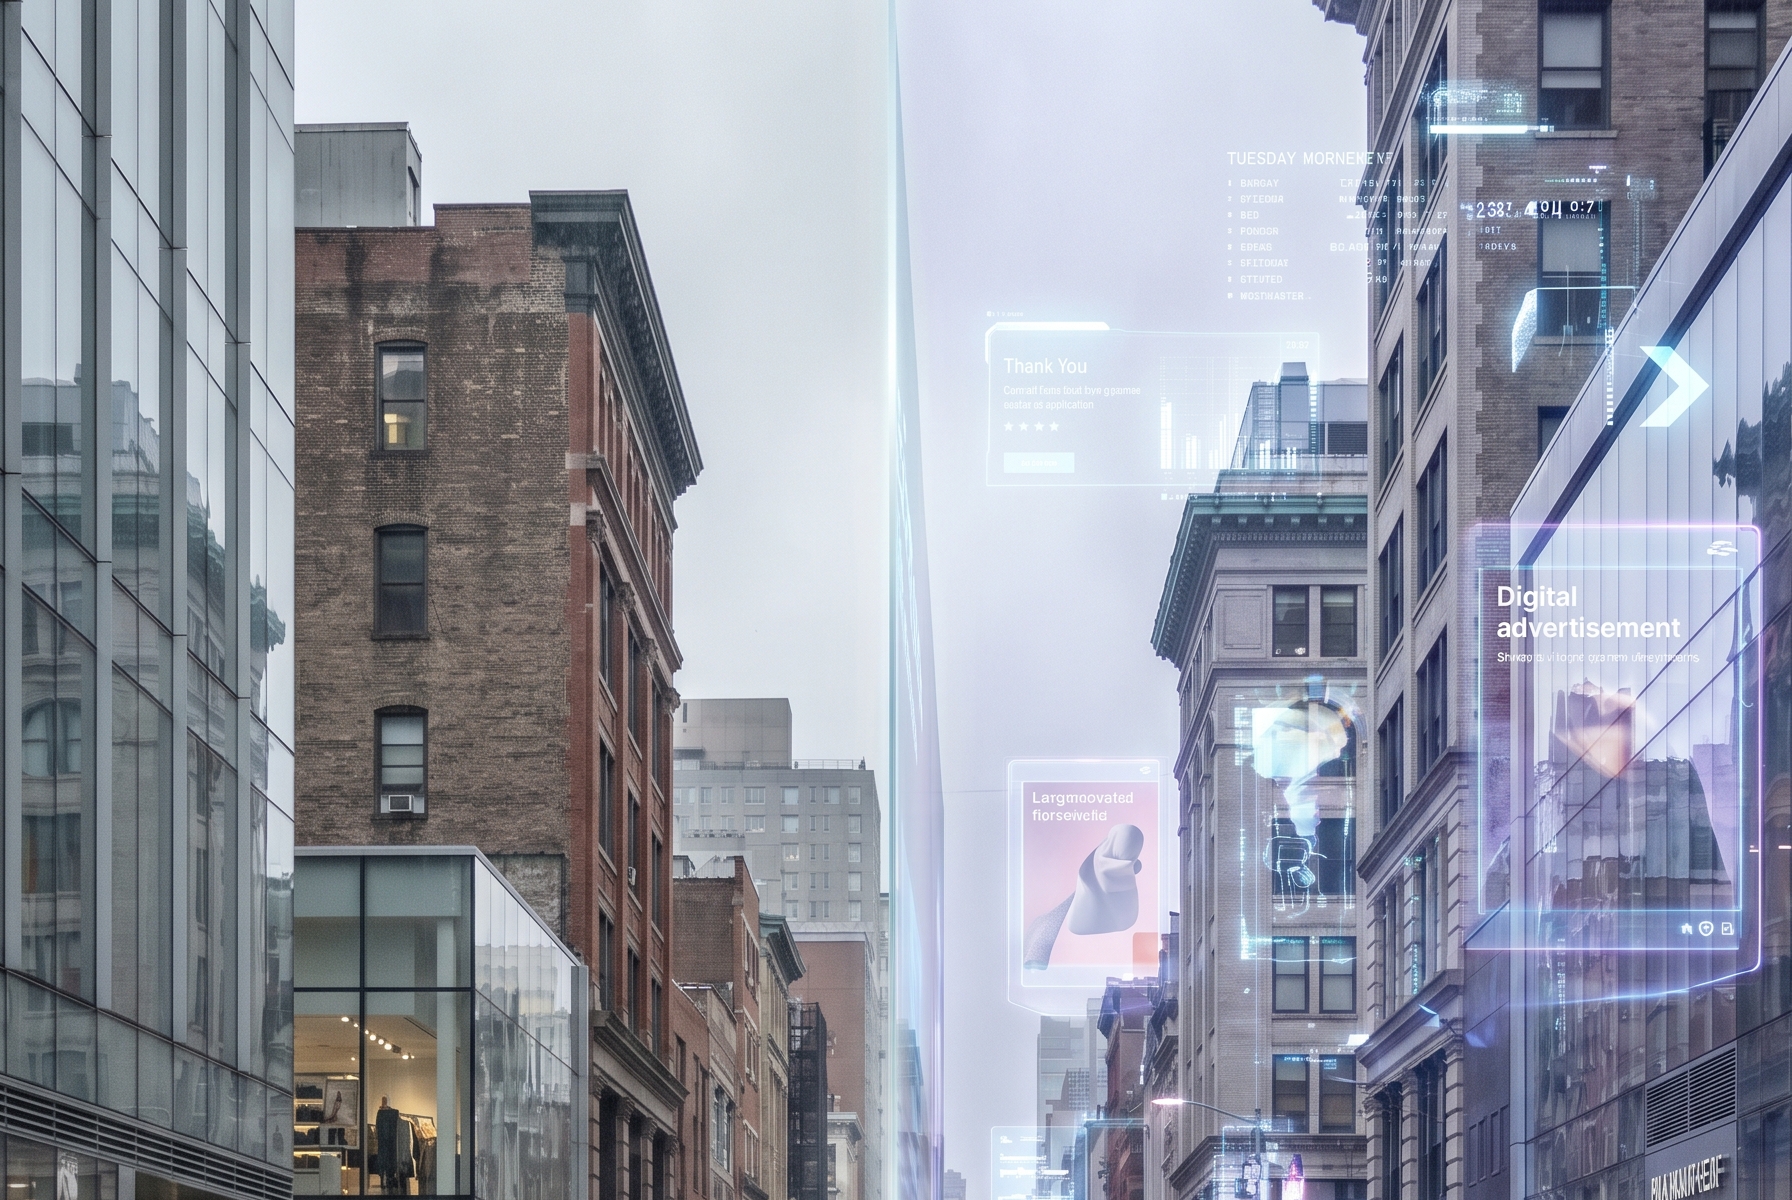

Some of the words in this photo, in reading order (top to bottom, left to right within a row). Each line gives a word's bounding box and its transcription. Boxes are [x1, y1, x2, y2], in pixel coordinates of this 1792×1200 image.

[1227, 152, 1296, 165] TUESDAY
[1240, 211, 1259, 219] BED
[1004, 357, 1053, 374] Thank
[1058, 357, 1087, 374] You
[1497, 585, 1577, 613] Digital
[1497, 616, 1681, 638] advertisement
